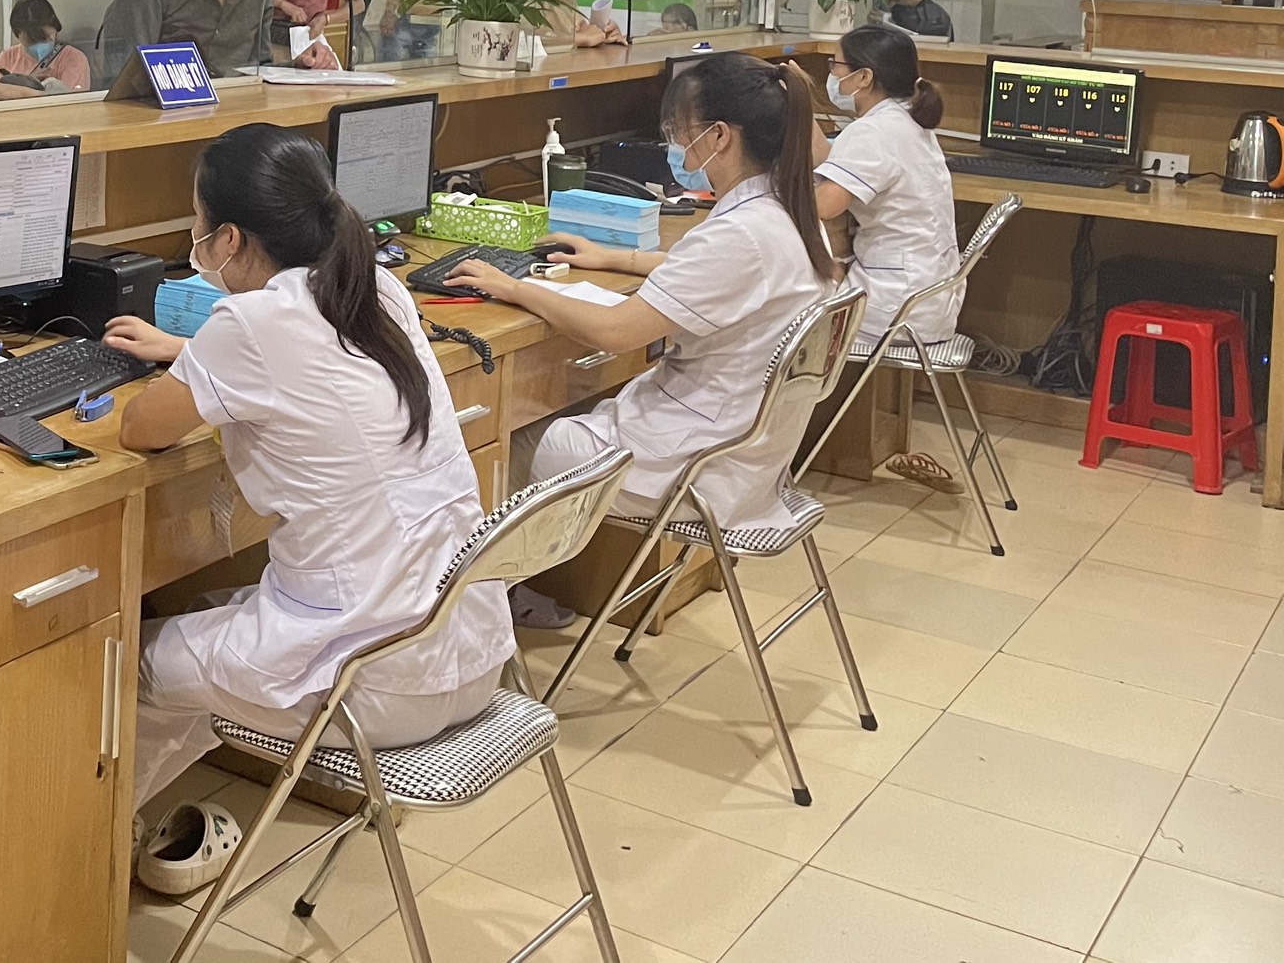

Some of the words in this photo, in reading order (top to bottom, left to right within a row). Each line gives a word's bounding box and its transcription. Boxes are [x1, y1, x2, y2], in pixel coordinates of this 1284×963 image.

[999, 81, 1014, 91] 117
[1026, 84, 1042, 94] 107
[1054, 87, 1069, 97] 118
[1082, 90, 1098, 100] 116
[1111, 93, 1126, 103] 115
